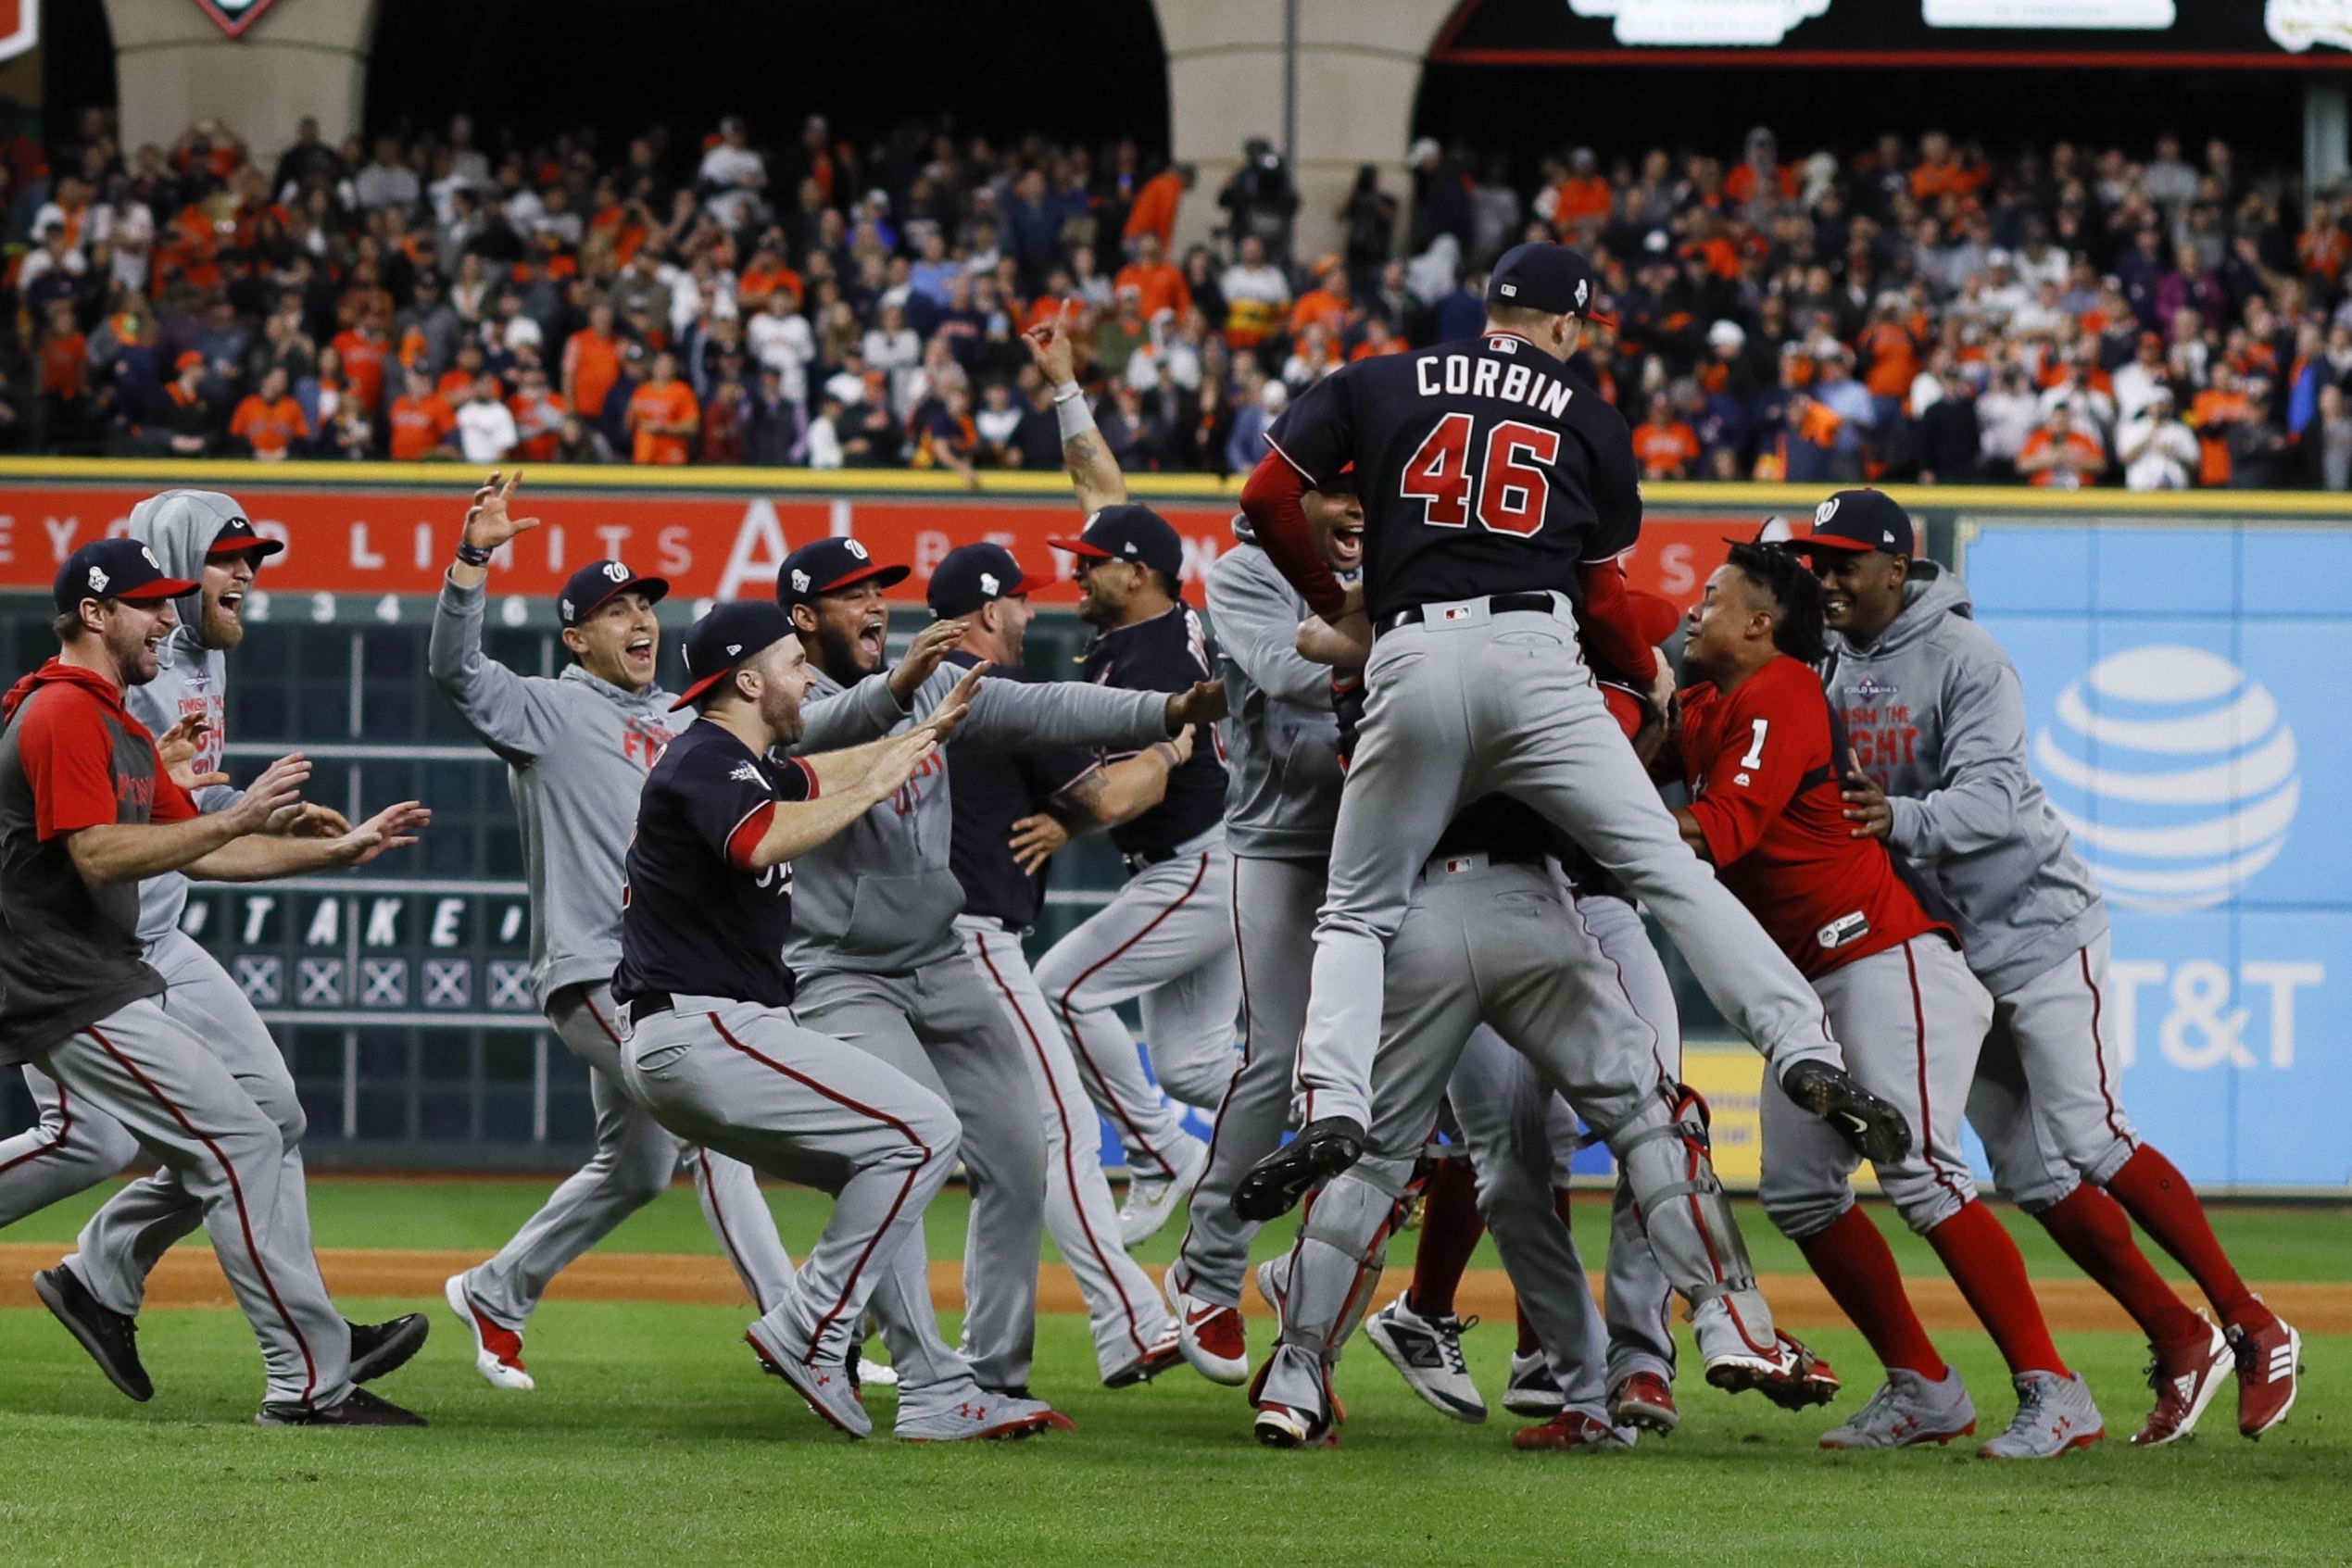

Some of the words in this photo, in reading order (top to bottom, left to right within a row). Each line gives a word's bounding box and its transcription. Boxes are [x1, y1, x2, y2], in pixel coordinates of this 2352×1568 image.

[1416, 355, 1573, 419] CORBIN
[1400, 412, 1561, 538] 46
[245, 590, 270, 621] 2
[311, 591, 337, 621] 3
[375, 594, 401, 622] 4
[501, 594, 529, 627] 6
[1740, 718, 1769, 771] 1
[1848, 726, 1920, 767] GHT
[2110, 960, 2324, 1070] T&T
